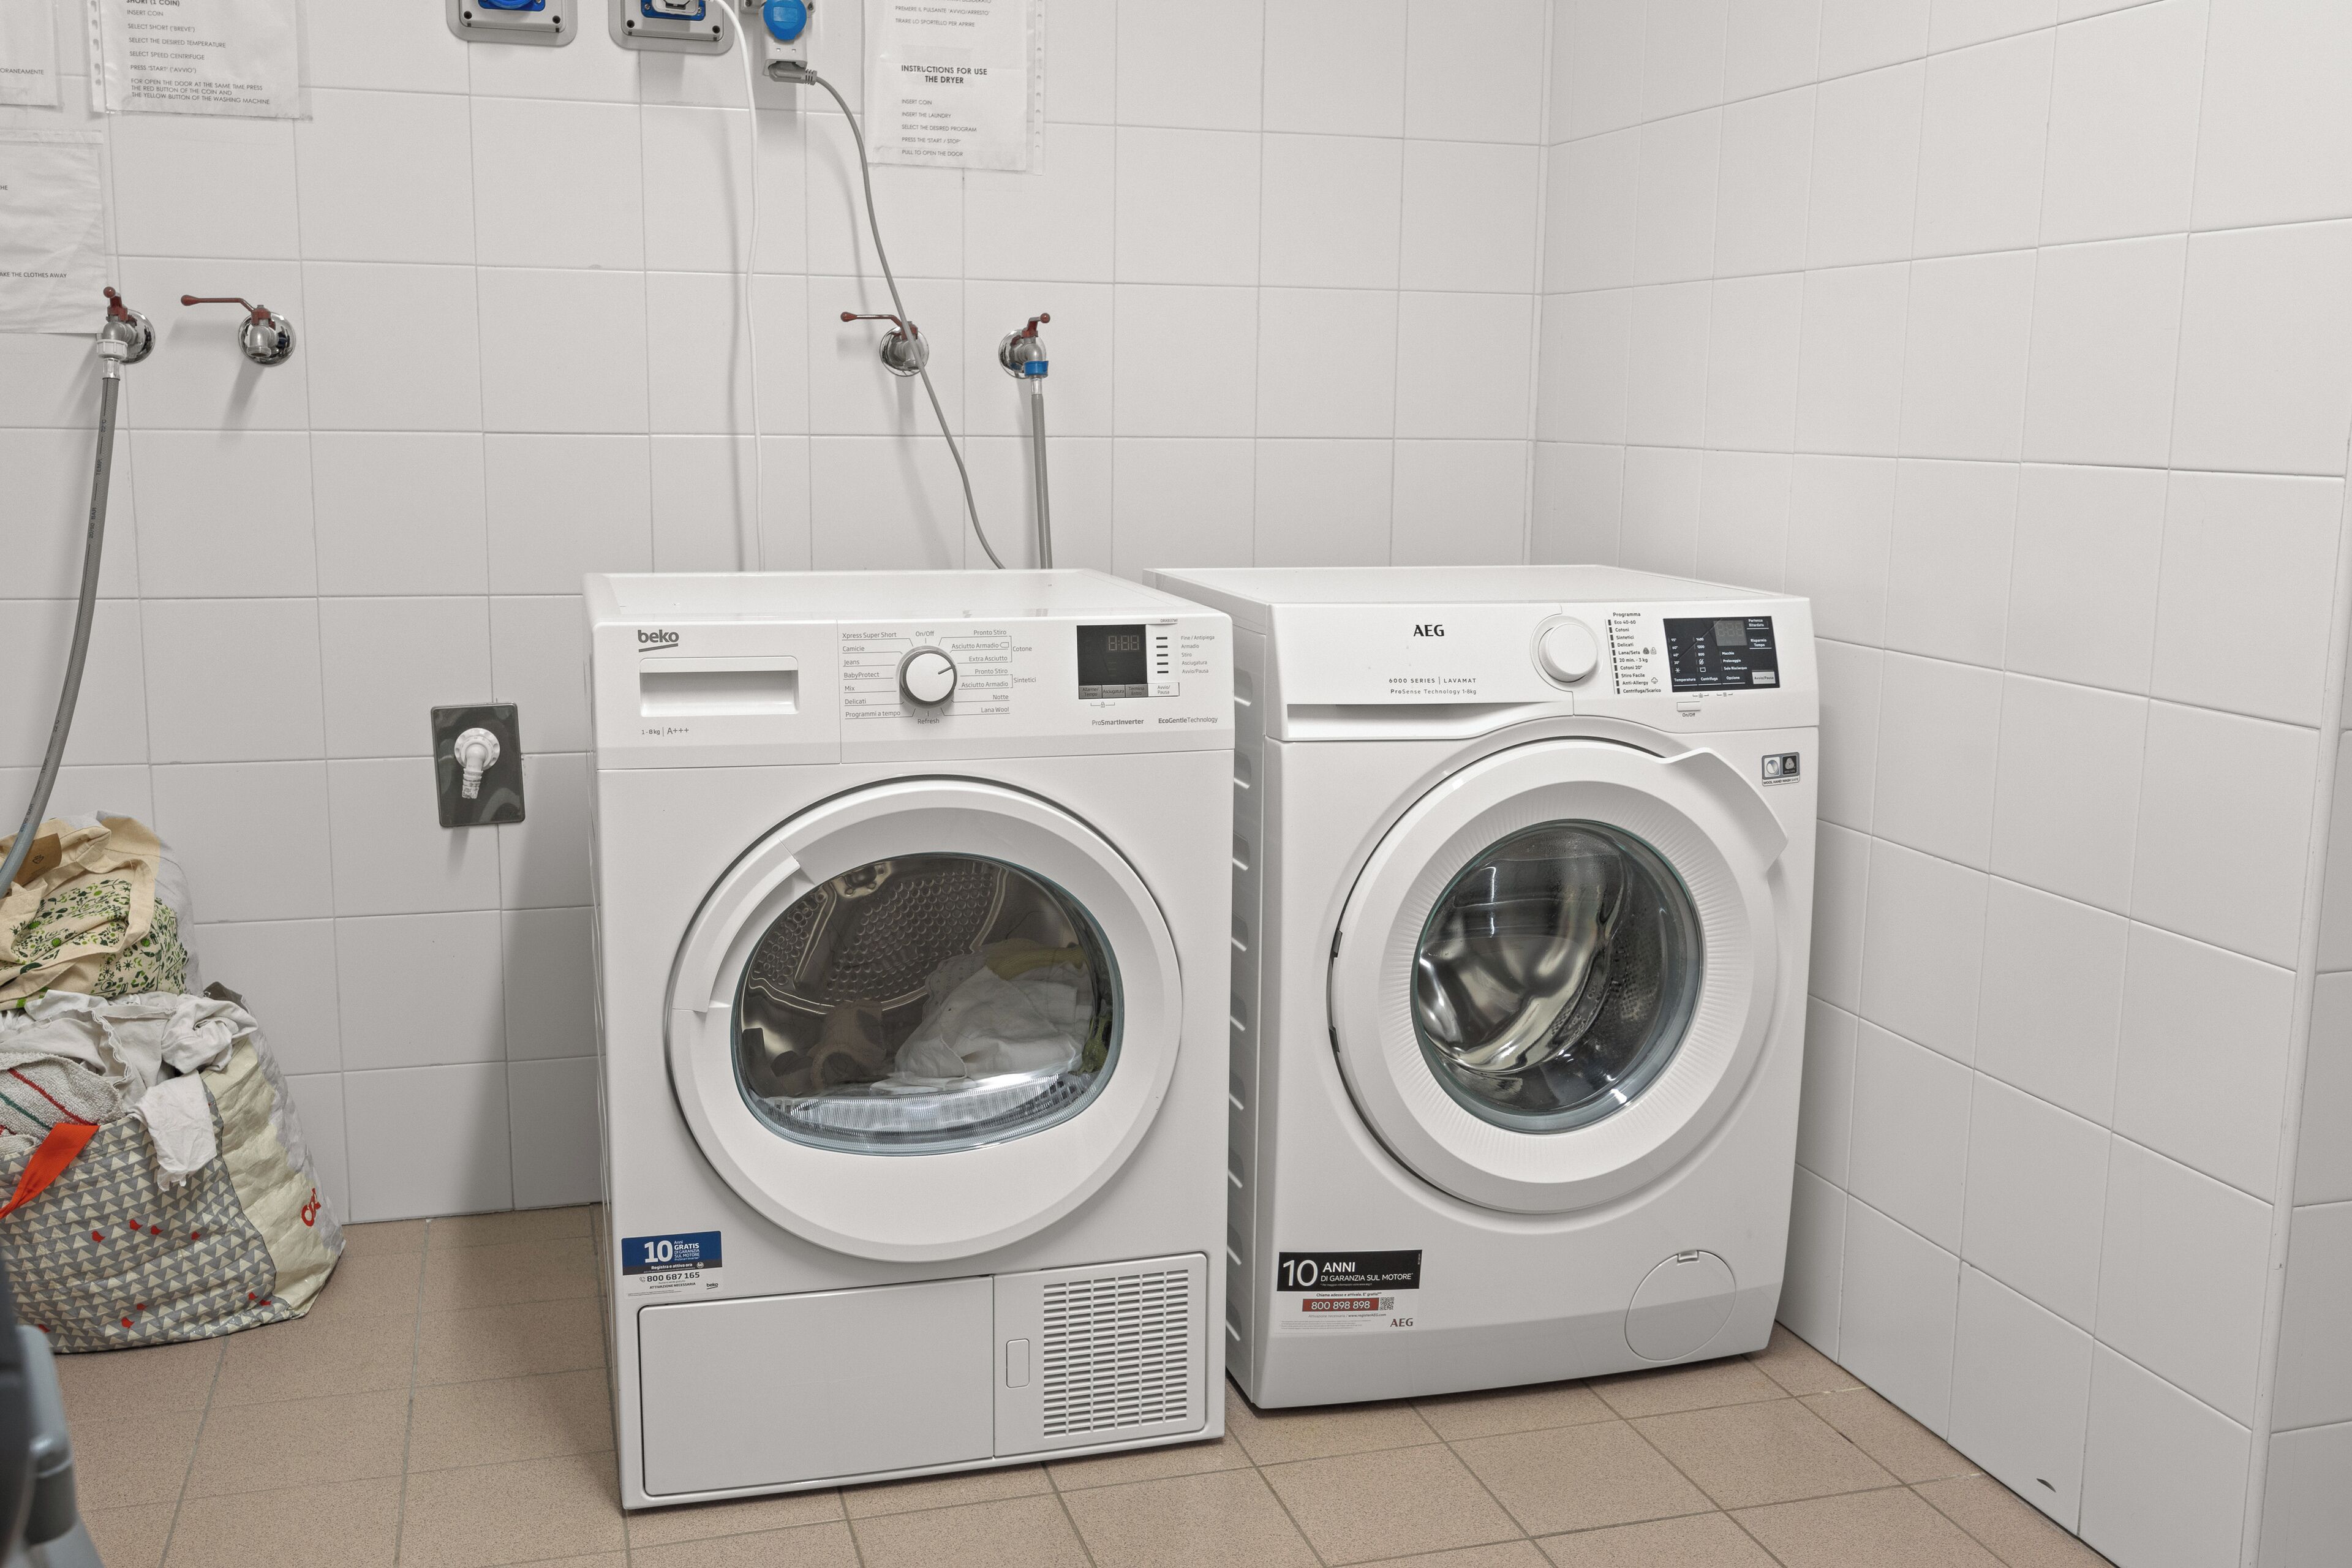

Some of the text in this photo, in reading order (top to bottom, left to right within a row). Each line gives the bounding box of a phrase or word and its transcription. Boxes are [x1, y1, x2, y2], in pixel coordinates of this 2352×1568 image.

[901, 65, 954, 74] INSTRUCTIONS
[638, 629, 679, 643] beko
[1413, 624, 1445, 637] AEG
[644, 1240, 673, 1263] 10
[1283, 1259, 1318, 1286] 10
[1322, 1262, 1355, 1272] ANNI
[1333, 1301, 1351, 1310] 898
[1352, 1300, 1370, 1309] 898
[1390, 1317, 1414, 1327] AEG
